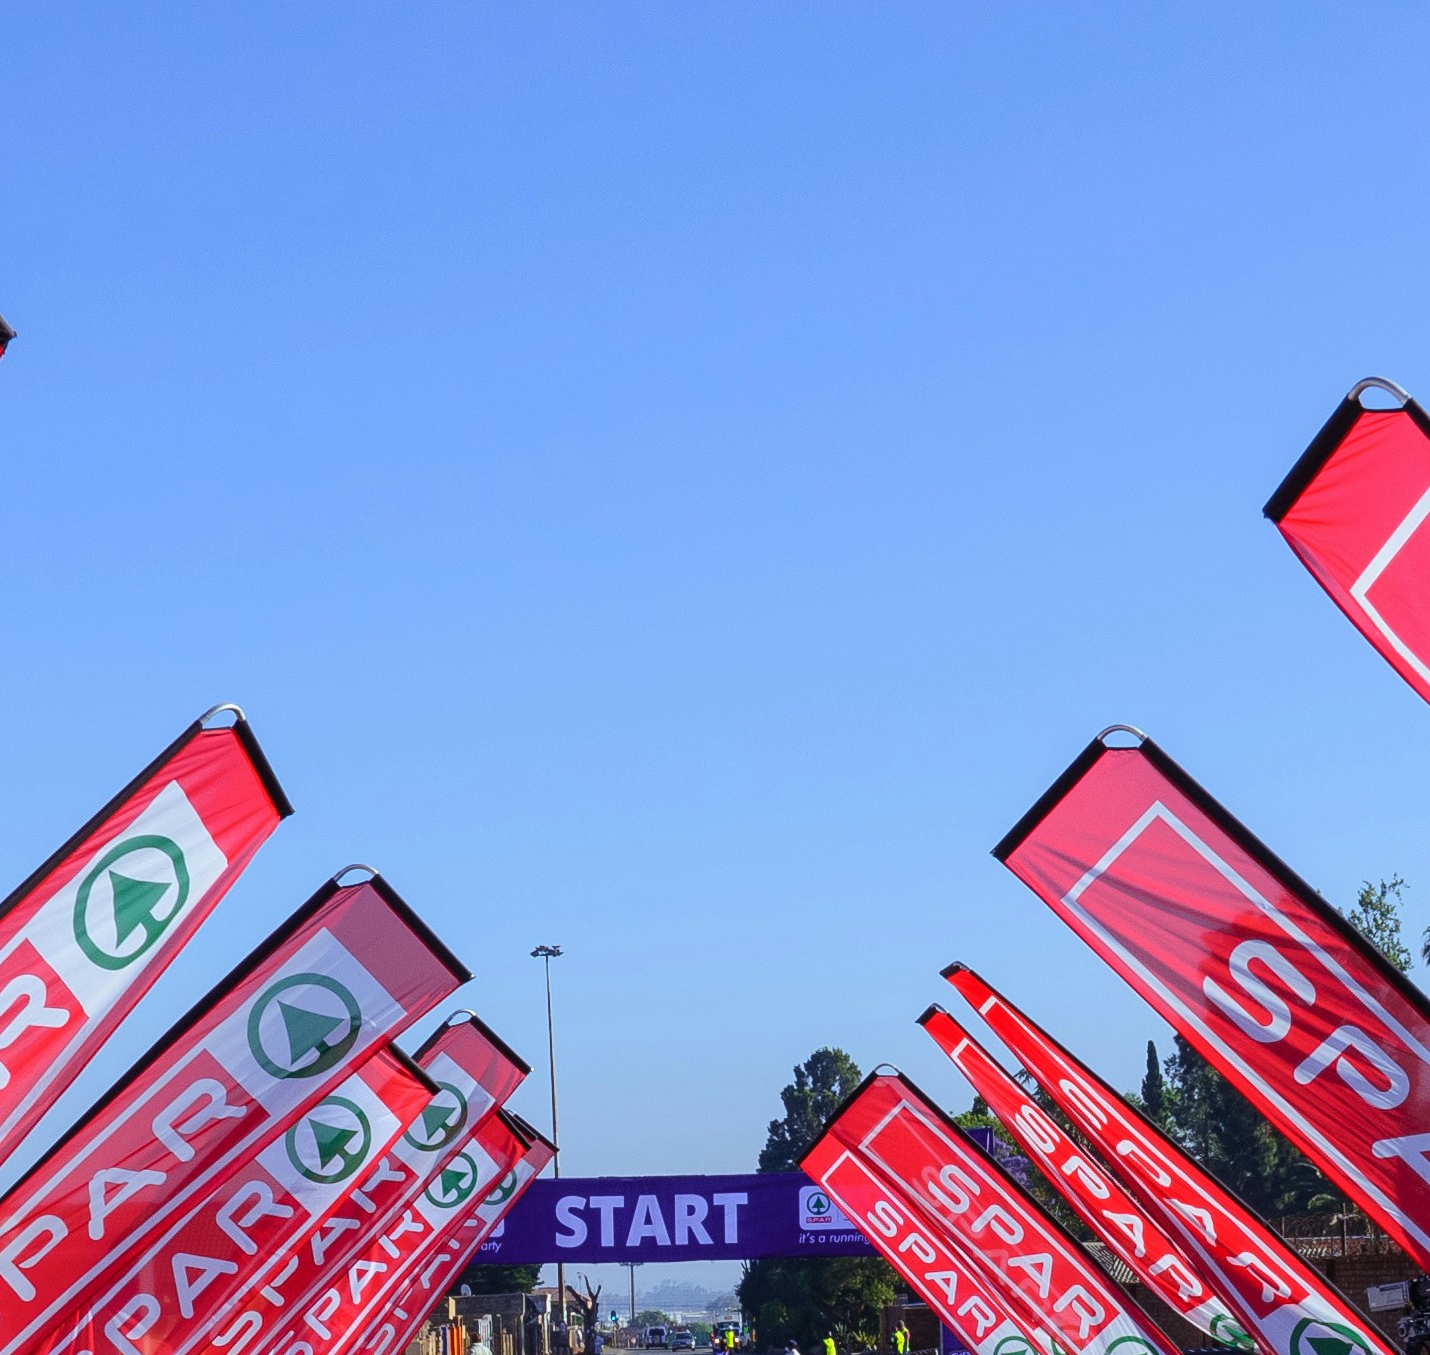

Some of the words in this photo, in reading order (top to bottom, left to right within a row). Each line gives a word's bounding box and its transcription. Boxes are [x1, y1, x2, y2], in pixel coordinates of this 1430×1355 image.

[480, 1241, 502, 1253] arty
[555, 1193, 749, 1248] START
[799, 1233, 815, 1243] it's
[818, 1235, 826, 1243] a
[1016, 1105, 1203, 1302] SPAR
[868, 1200, 997, 1338] SPAR
[929, 1164, 1106, 1340] SPAR
